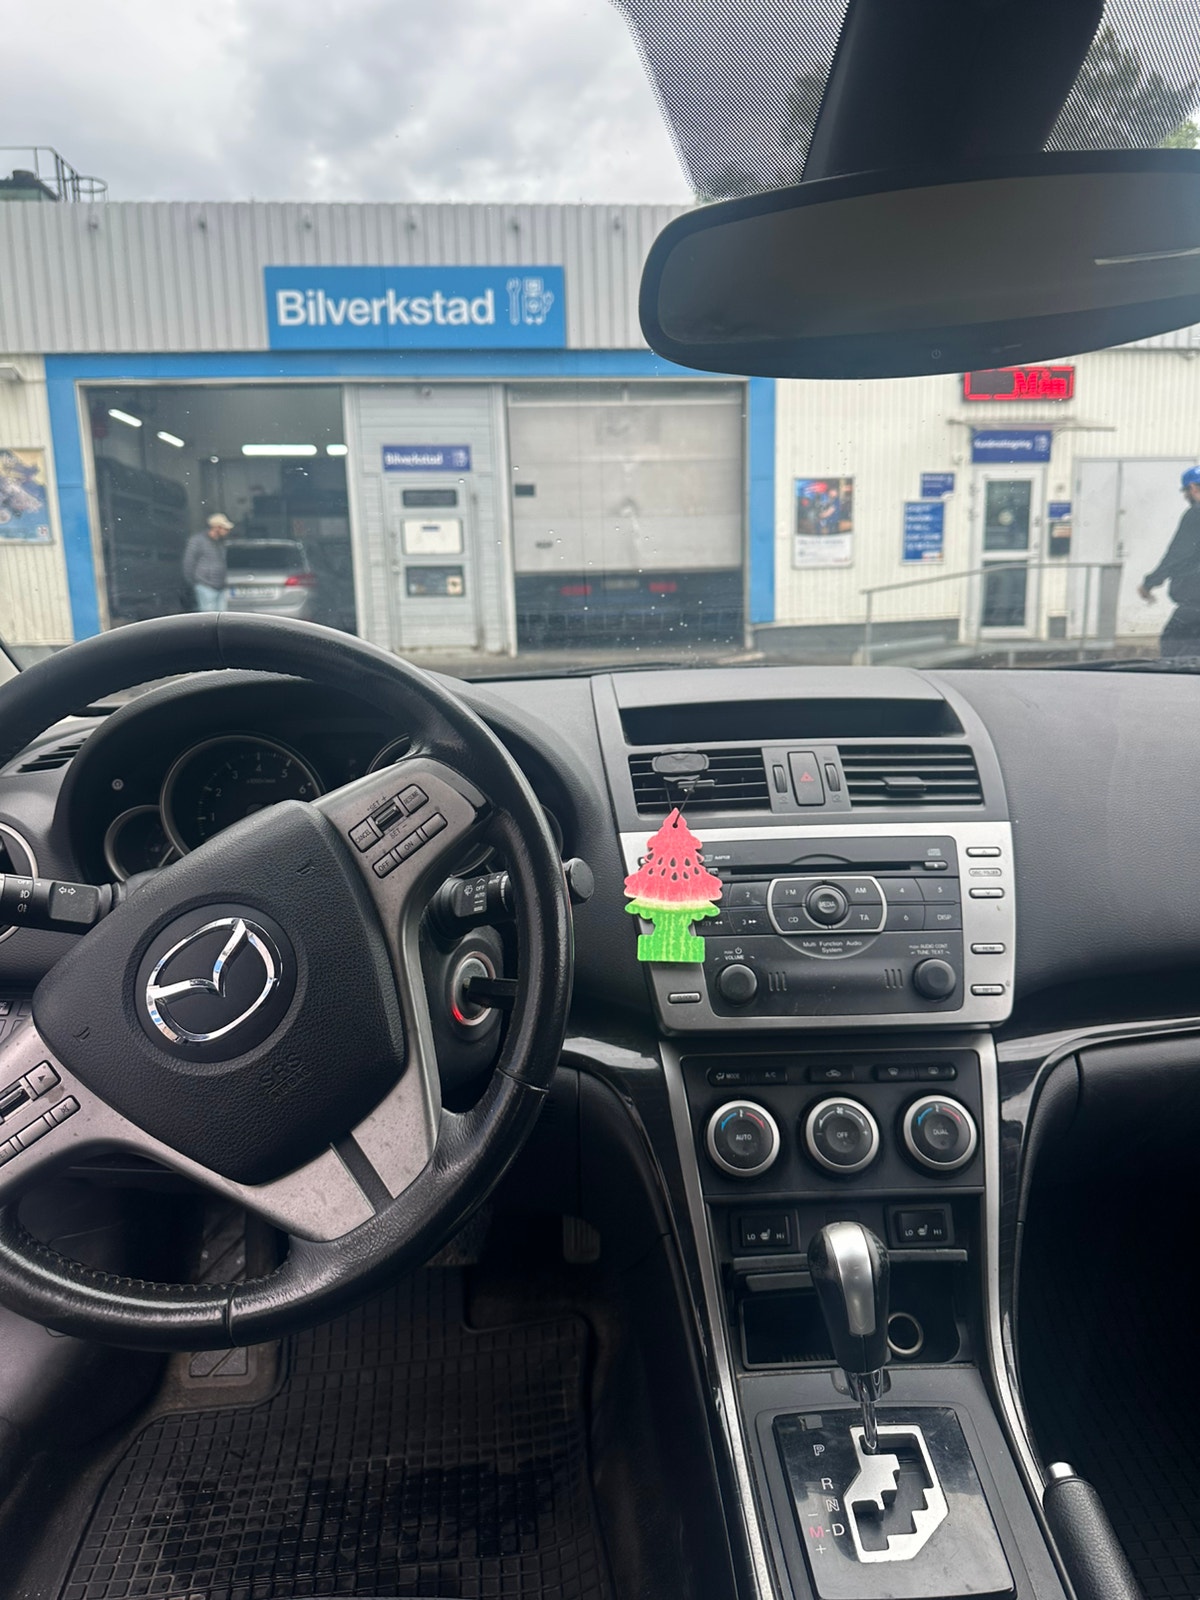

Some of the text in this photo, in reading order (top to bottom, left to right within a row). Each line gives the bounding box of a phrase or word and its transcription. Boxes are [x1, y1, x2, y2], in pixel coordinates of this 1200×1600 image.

[275, 288, 495, 326] Bilverkstad
[378, 861, 390, 871] OFF
[813, 1444, 825, 1456] P
[820, 1477, 834, 1490] R
[825, 1498, 840, 1513] N
[831, 1522, 845, 1536] D
